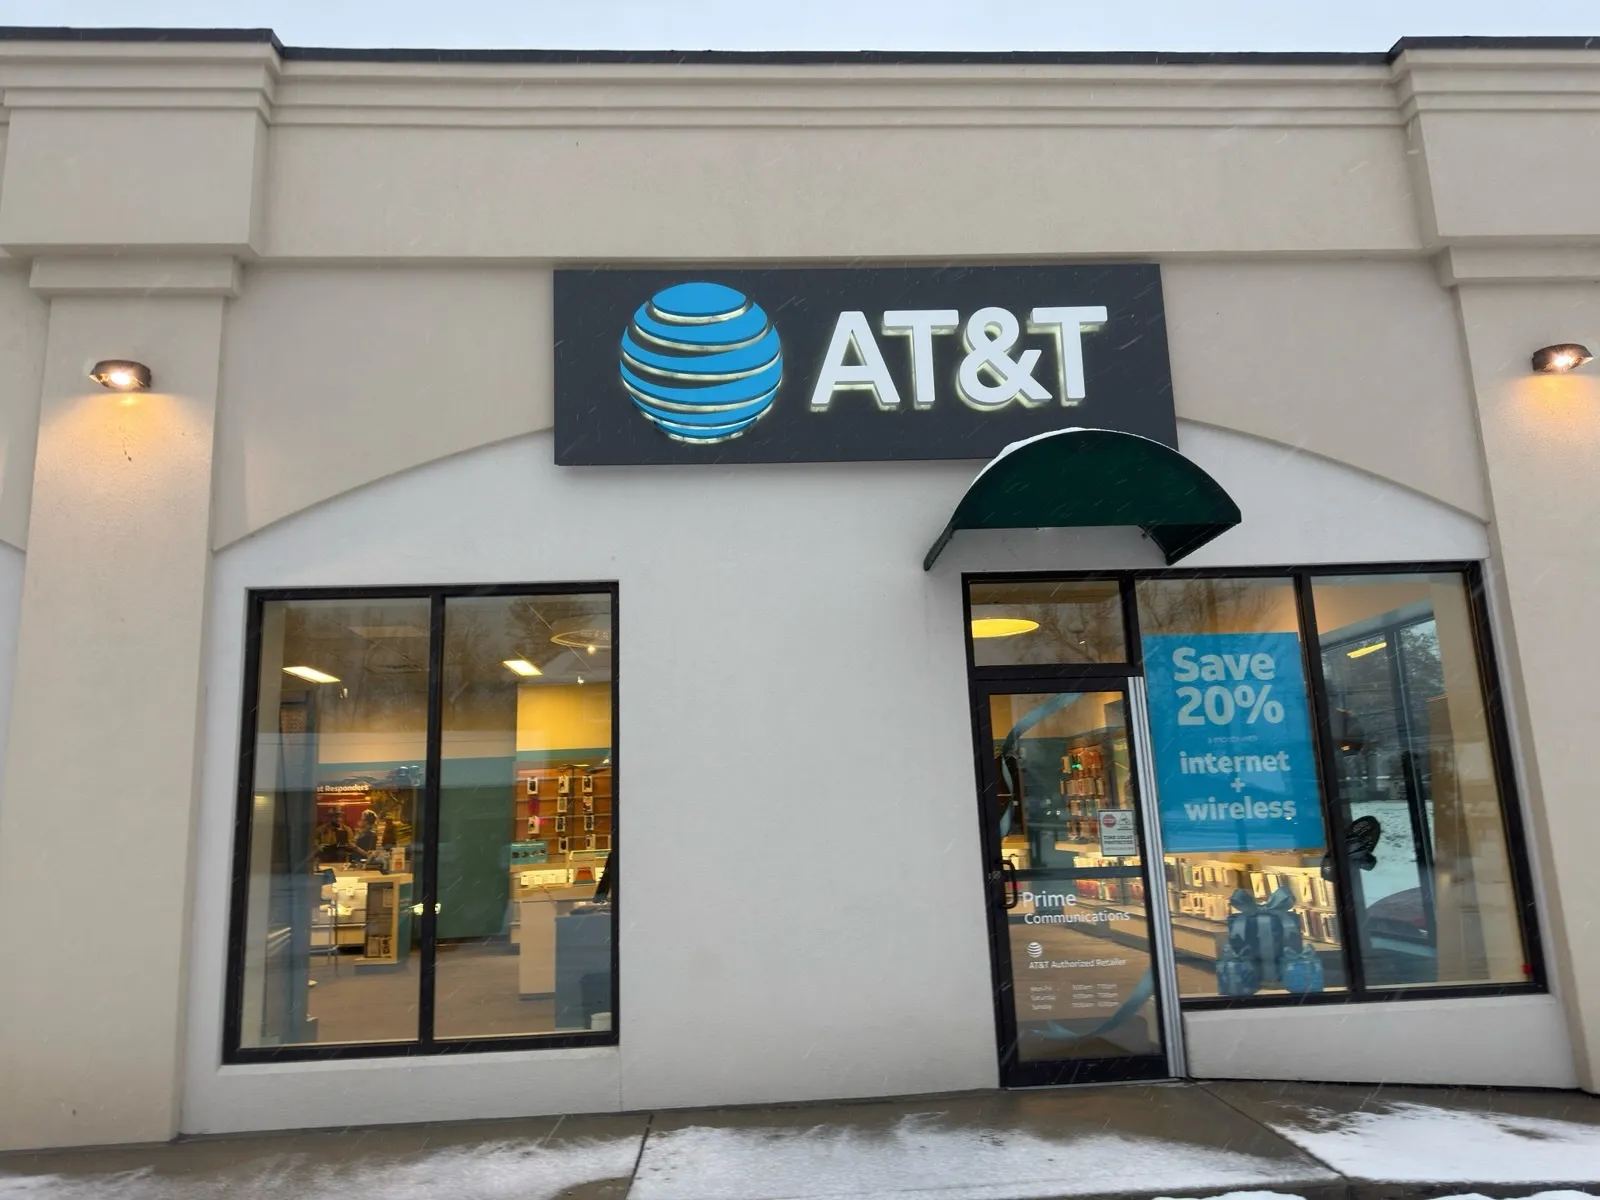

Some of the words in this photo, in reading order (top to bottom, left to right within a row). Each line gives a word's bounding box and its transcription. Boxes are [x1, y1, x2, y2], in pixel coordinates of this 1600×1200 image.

[810, 305, 1108, 409] AT&T
[1172, 647, 1276, 682] Save
[1176, 685, 1285, 726] 20%
[1179, 750, 1291, 774] internet
[1184, 796, 1297, 821] wireless
[1022, 890, 1077, 908] Prime
[1024, 910, 1131, 925] Communications
[1028, 961, 1050, 969] AT&T
[1051, 959, 1095, 969] Authorized
[1096, 957, 1127, 968] Retailer
